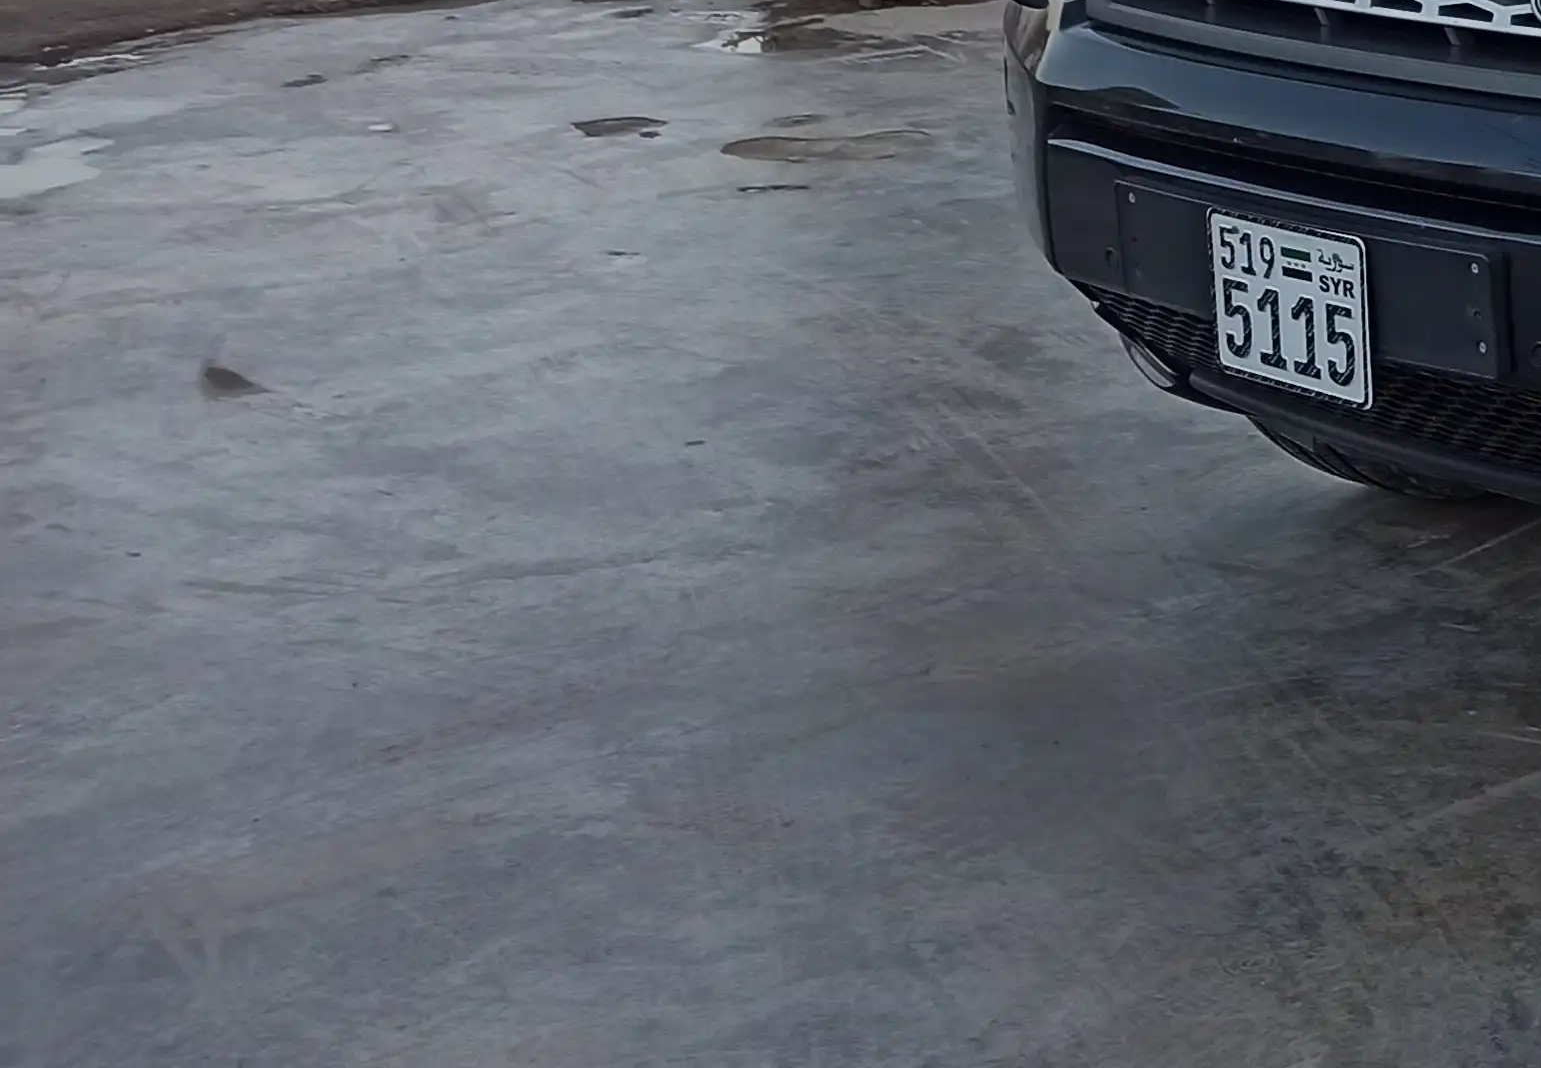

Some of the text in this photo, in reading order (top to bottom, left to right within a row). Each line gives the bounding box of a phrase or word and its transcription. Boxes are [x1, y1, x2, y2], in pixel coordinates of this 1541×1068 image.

[1218, 225, 1276, 280] 519
[1319, 275, 1355, 299] SYR
[1222, 278, 1356, 387] 5115
